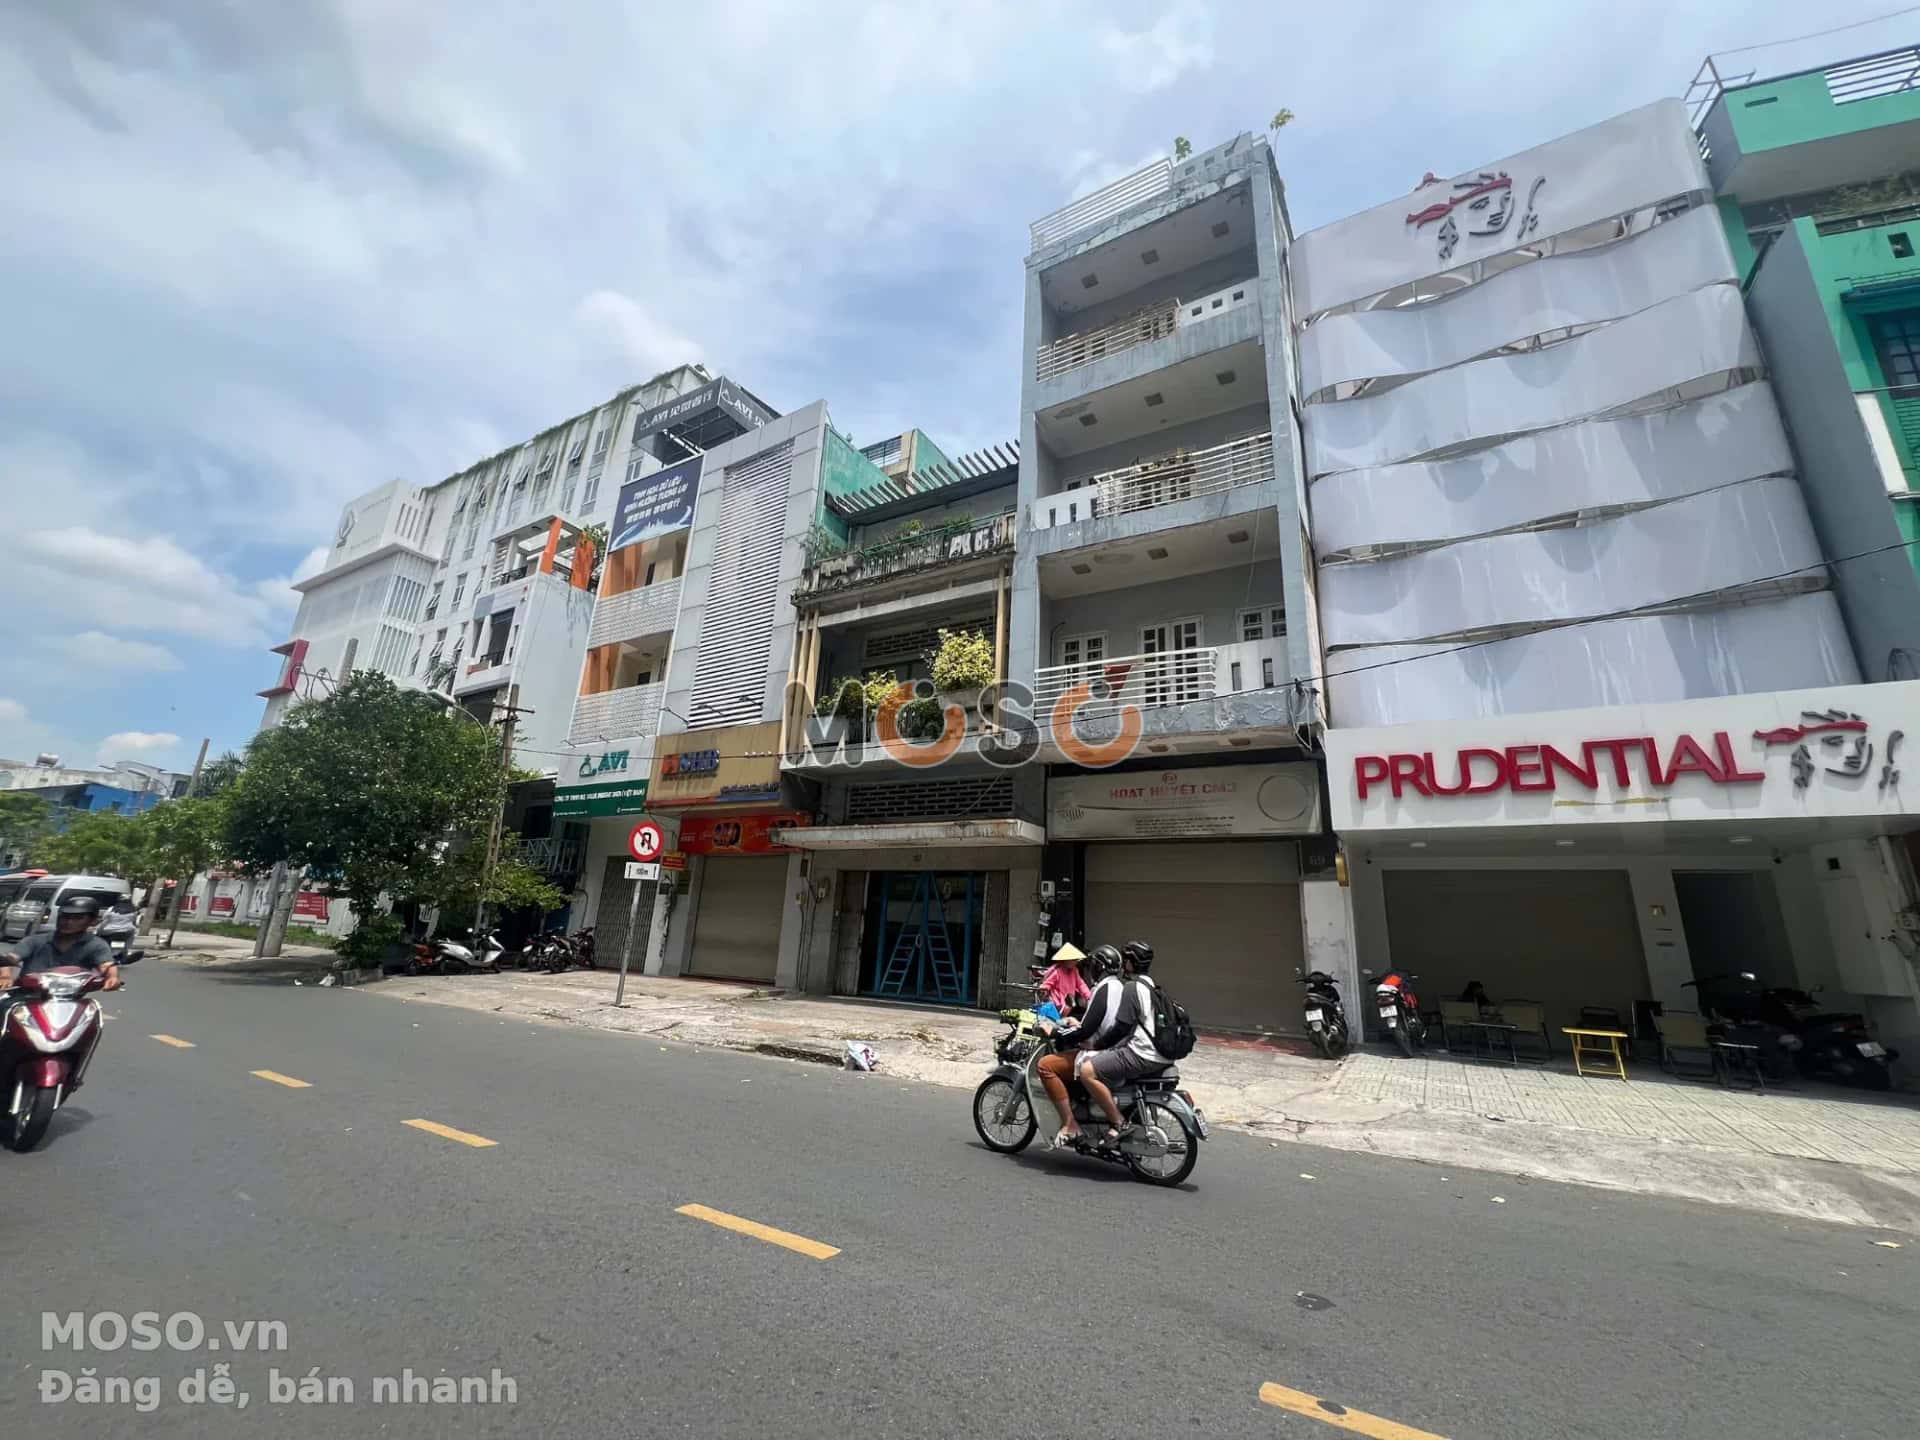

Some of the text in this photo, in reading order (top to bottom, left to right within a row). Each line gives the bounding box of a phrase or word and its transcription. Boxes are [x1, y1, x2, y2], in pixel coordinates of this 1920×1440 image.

[650, 410, 668, 425] AVI
[733, 399, 753, 421] AVI
[599, 749, 630, 771] AVI
[1354, 731, 1766, 800] PRUDENTIAL
